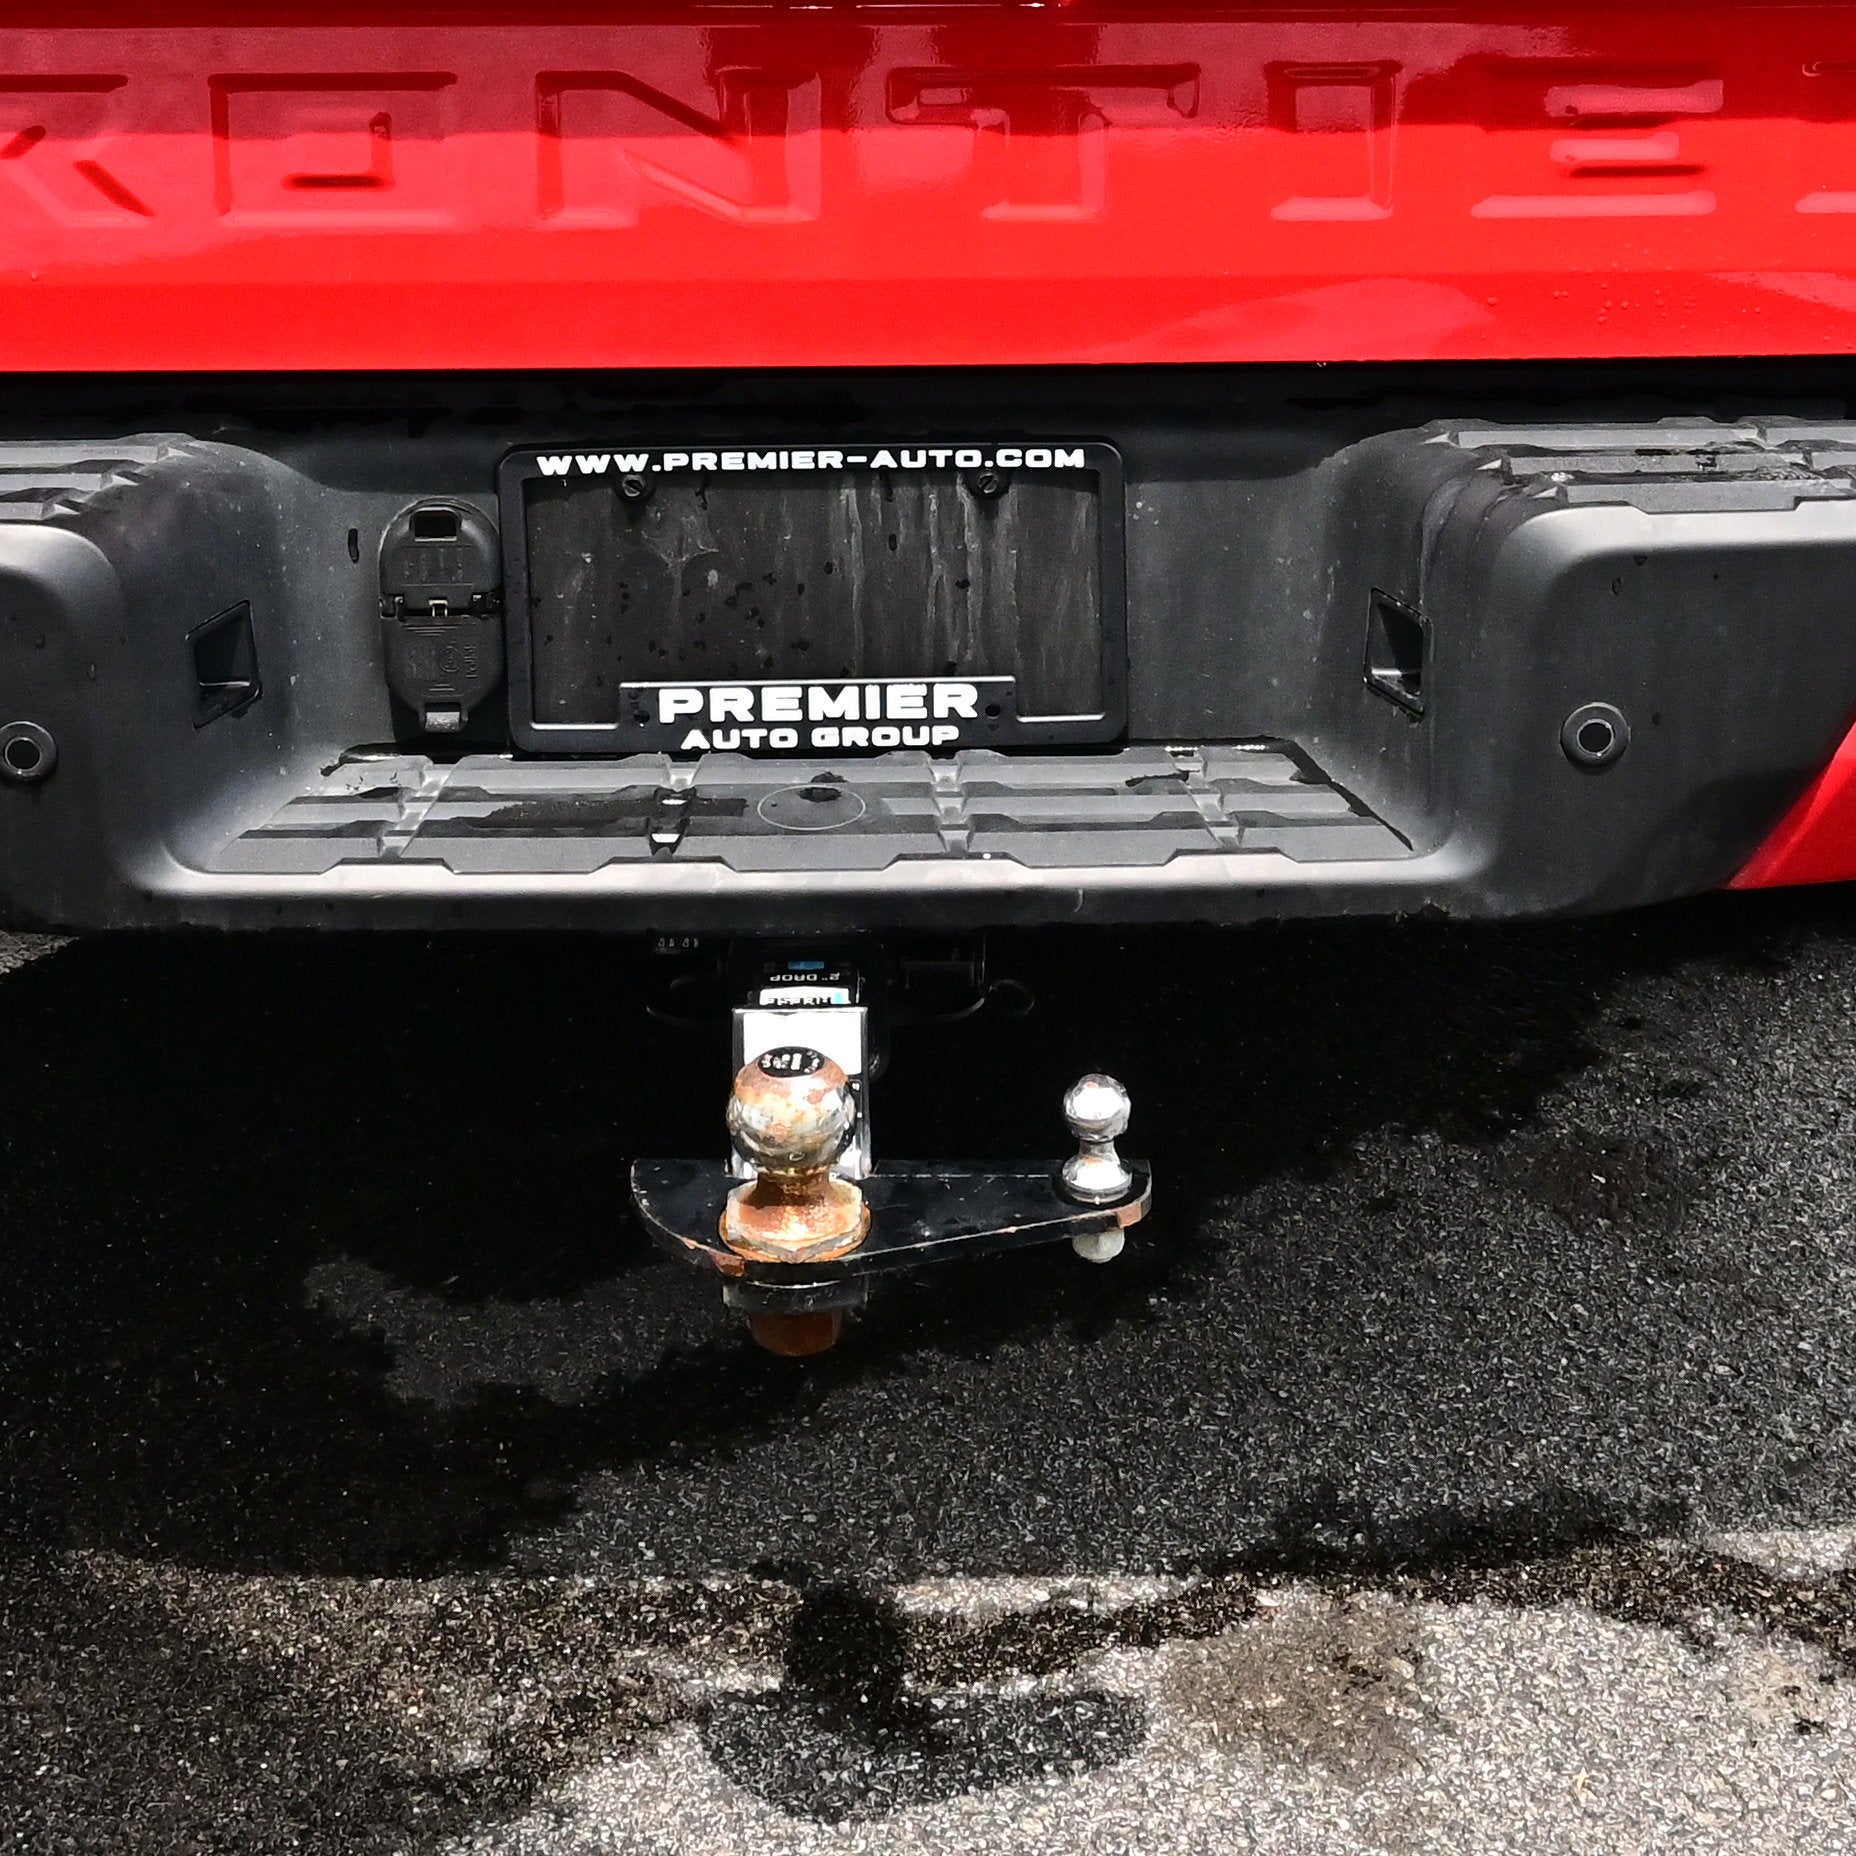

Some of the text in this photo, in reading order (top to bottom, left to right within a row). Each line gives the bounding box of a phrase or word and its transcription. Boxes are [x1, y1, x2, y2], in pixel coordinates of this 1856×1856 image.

[536, 448, 1086, 476] WWW.PREMIER-AUTO.COM
[658, 682, 978, 724] PREMIER
[680, 725, 959, 750] AUTO GROUP
[769, 973, 818, 982] DROP
